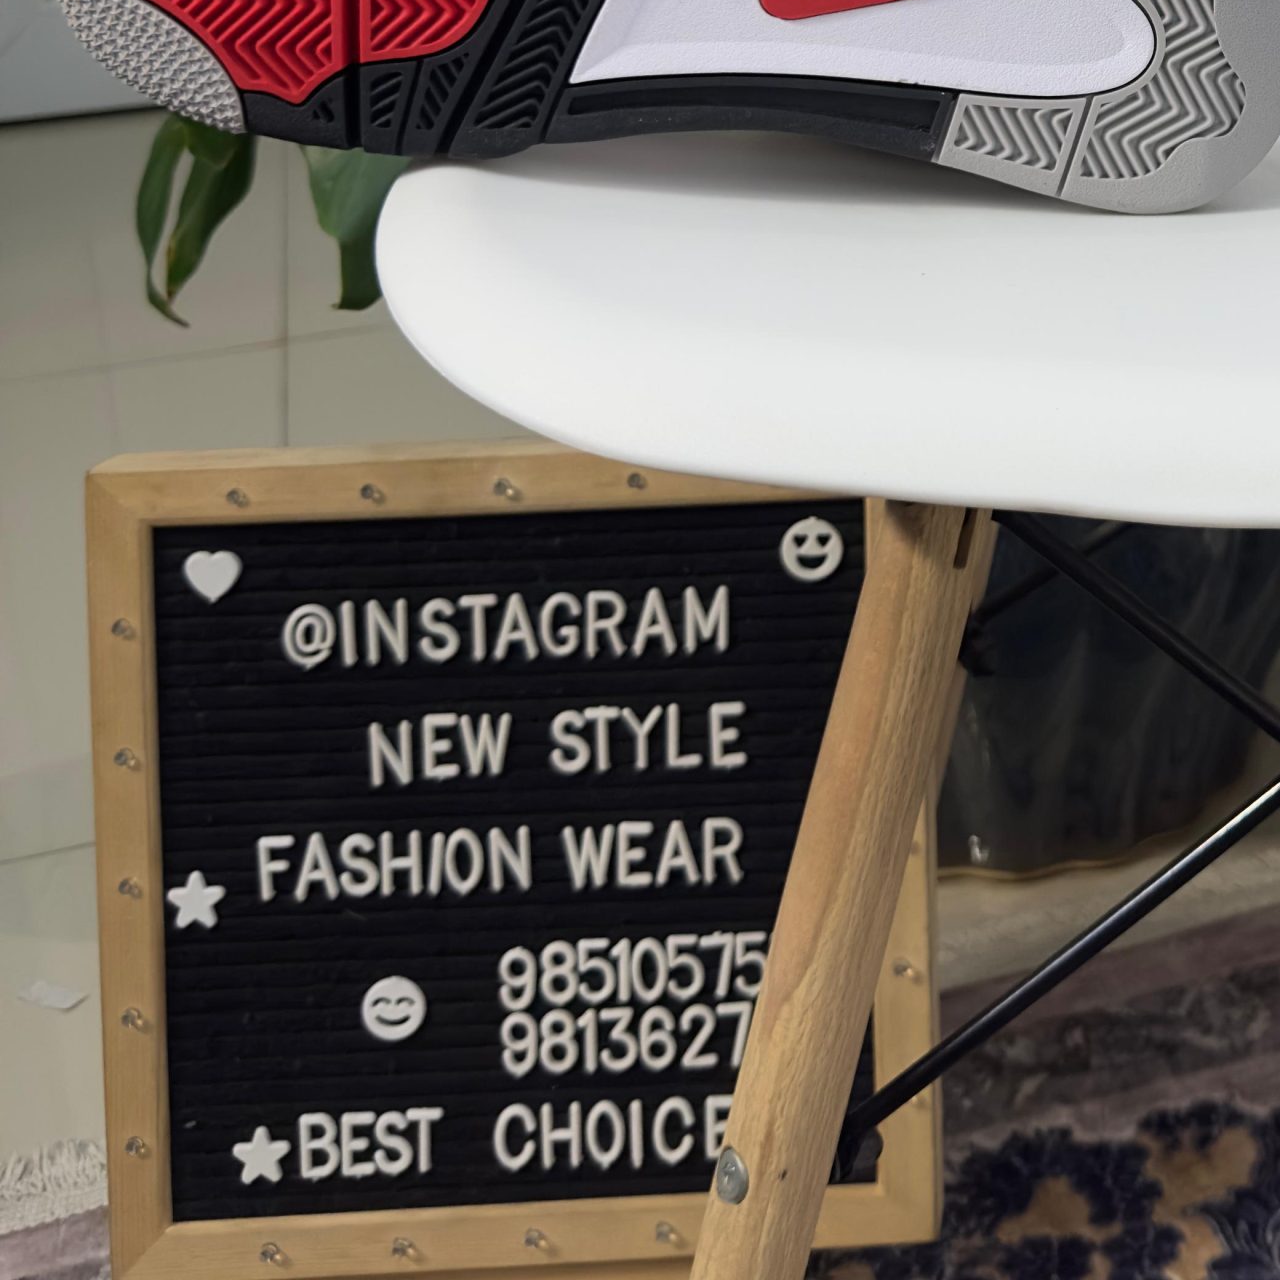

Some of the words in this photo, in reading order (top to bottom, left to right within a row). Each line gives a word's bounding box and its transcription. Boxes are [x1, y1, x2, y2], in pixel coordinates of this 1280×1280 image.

[282, 585, 730, 669] @INSTAGRAM
[368, 712, 512, 787] NEW
[550, 701, 747, 774] STYLE
[257, 825, 531, 902] FASHION
[562, 817, 743, 890] WEAR
[499, 931, 775, 1011] 98510575
[501, 1001, 753, 1077] 9813627
[298, 1107, 443, 1181] BEST
[493, 1095, 733, 1171] CHOICE
